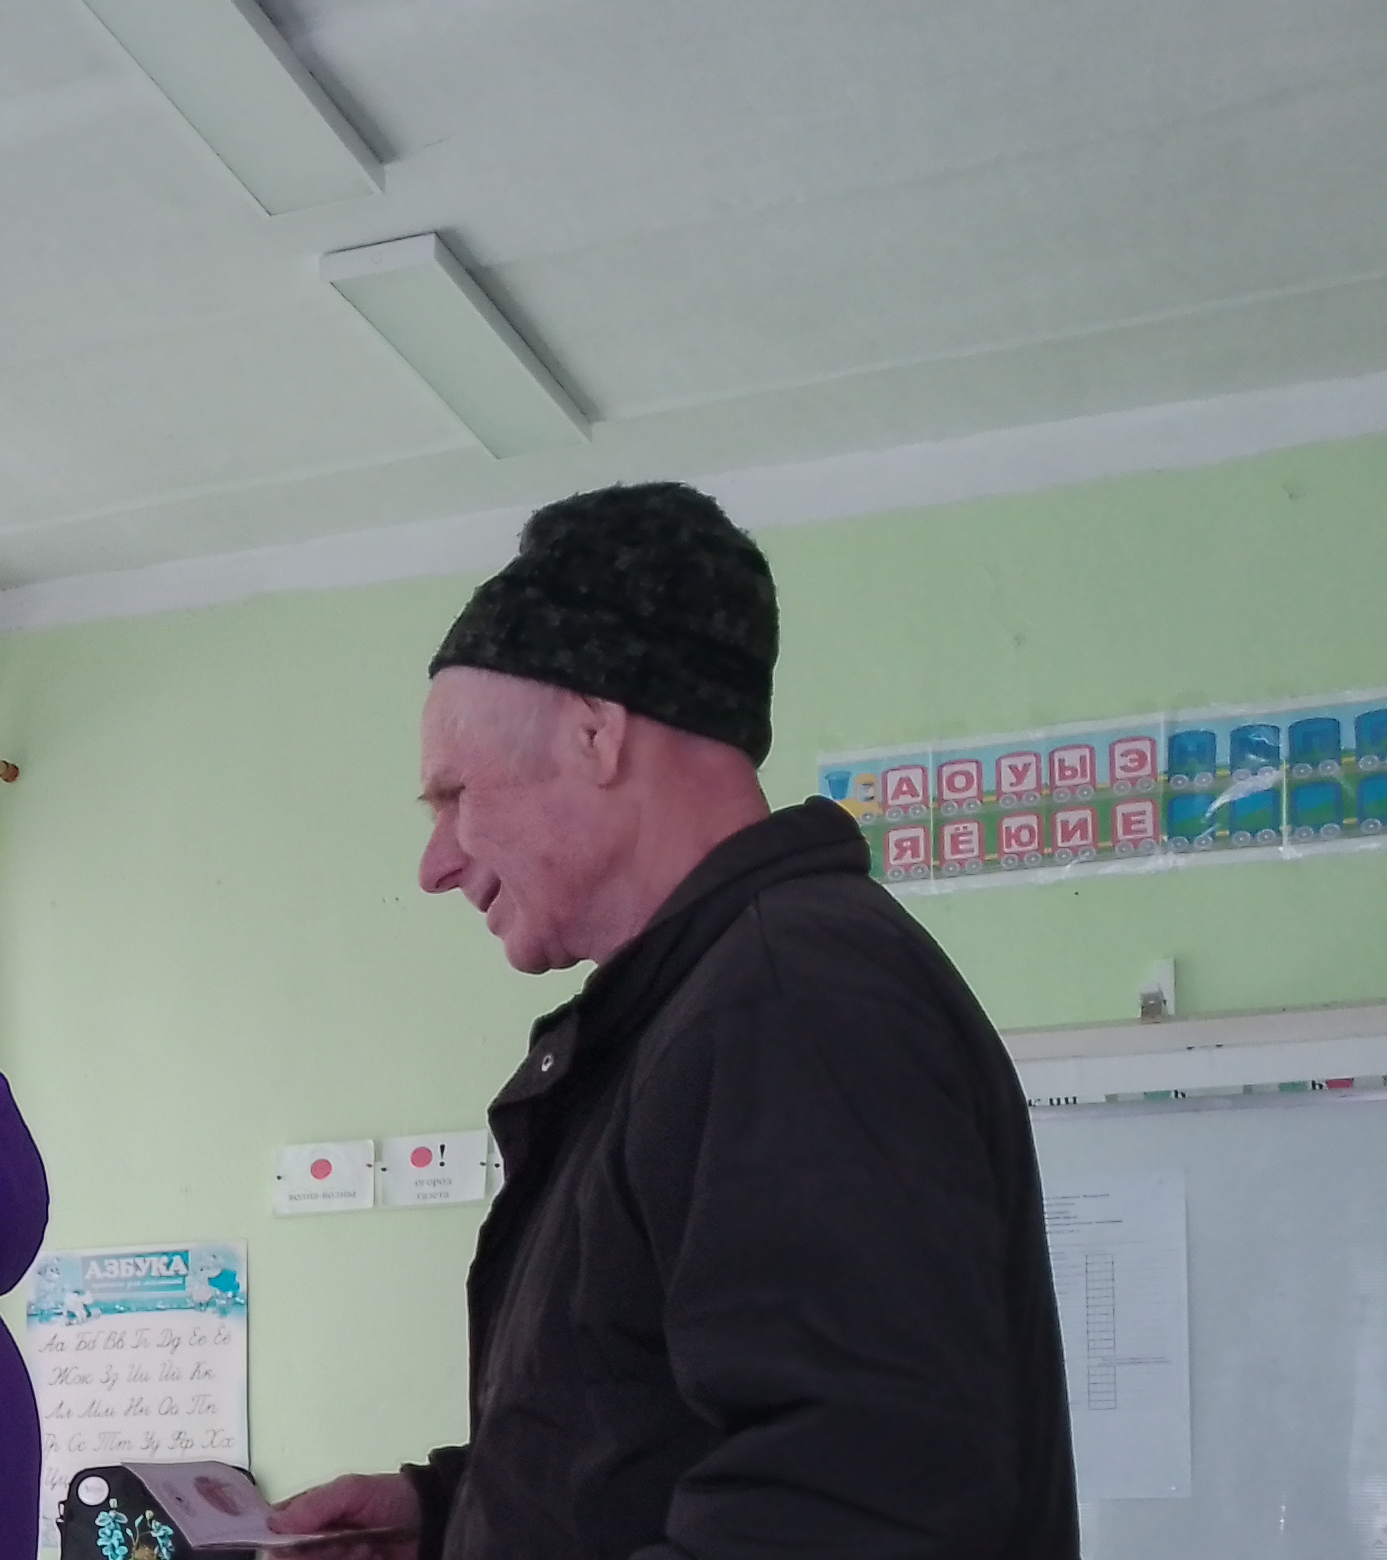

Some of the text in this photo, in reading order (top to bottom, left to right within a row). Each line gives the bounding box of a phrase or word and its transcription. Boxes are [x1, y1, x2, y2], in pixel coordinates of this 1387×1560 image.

[891, 776, 921, 801] А
[945, 770, 976, 794] О
[1008, 762, 1032, 788] У
[1057, 755, 1088, 782] Ы
[1119, 748, 1149, 773] Э
[893, 810, 1147, 861] Я Ё Ю И Е
[86, 1255, 188, 1279] АЗБУКА
